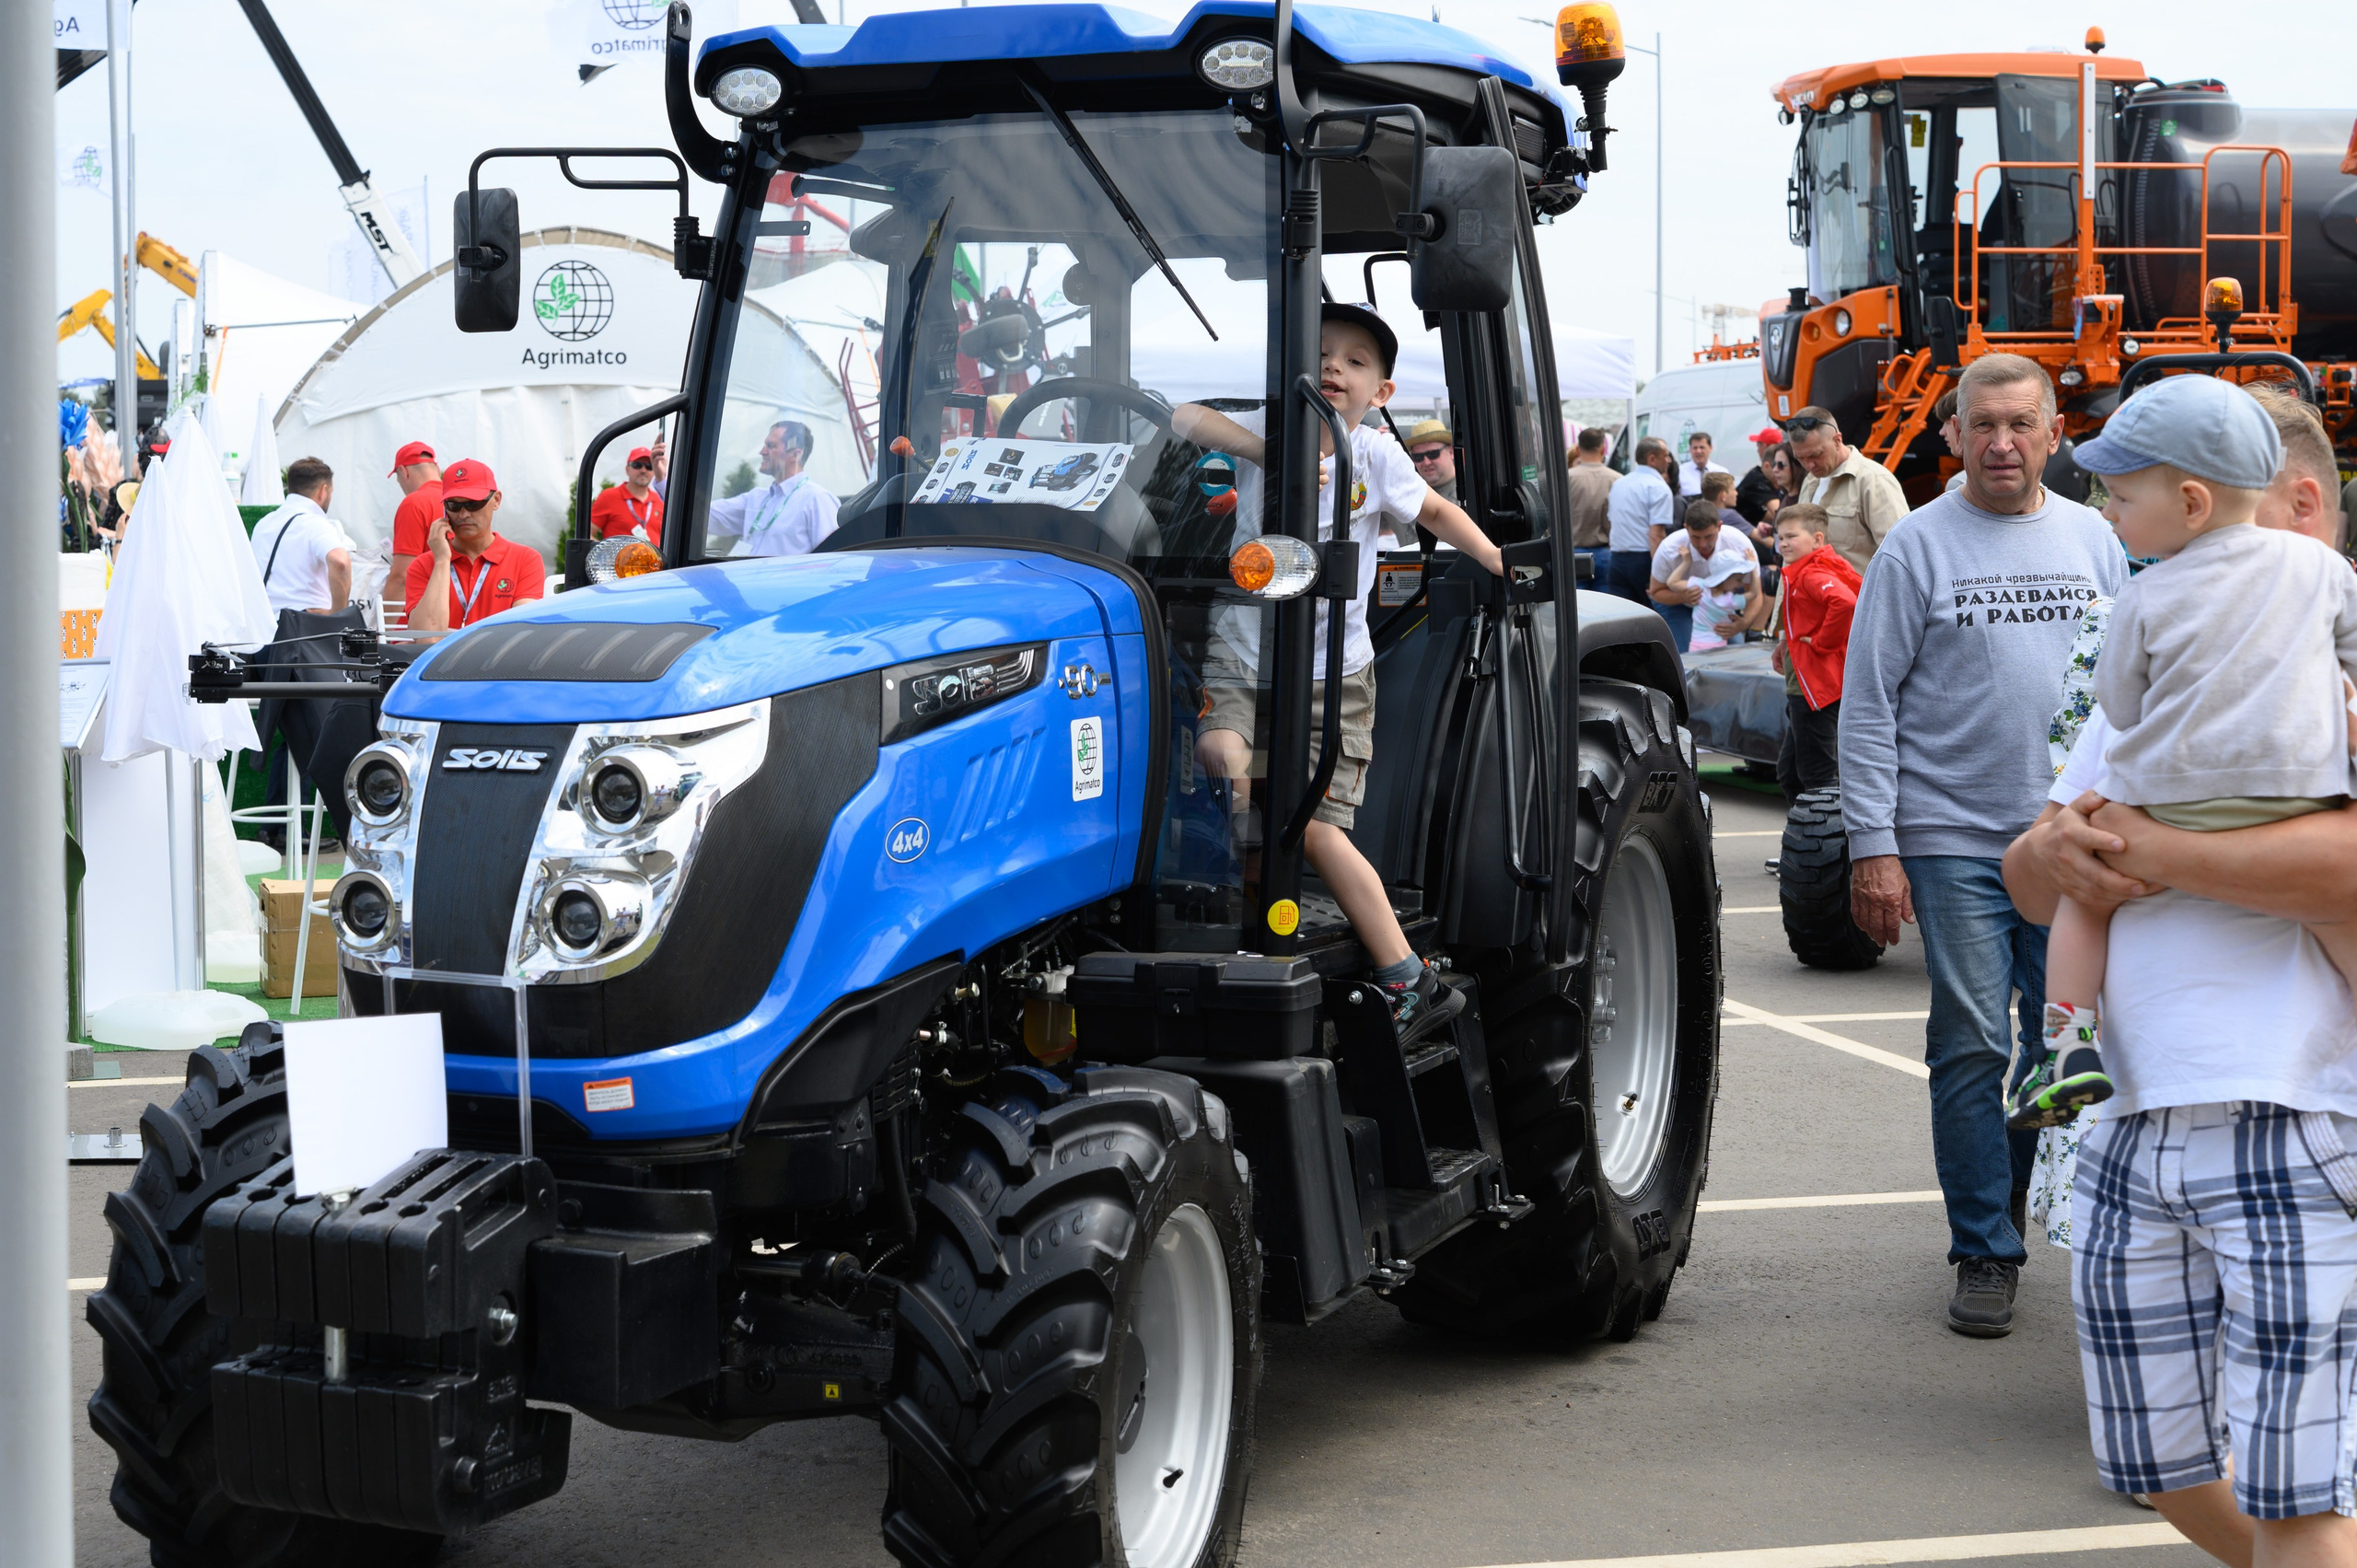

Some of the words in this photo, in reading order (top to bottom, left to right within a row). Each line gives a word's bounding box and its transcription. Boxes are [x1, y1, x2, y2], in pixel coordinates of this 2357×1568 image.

[360, 211, 394, 253] MST
[521, 348, 627, 369] Agrimatco
[1952, 574, 2002, 588] Никакой
[1955, 586, 2097, 608] РАЗДЕВАЙСЯ
[1956, 610, 1974, 629] И
[1987, 605, 2084, 623] РАБОТА
[1064, 664, 1097, 700] 90
[1074, 778, 1101, 795] Agrimatco
[892, 826, 923, 854] 4x4
